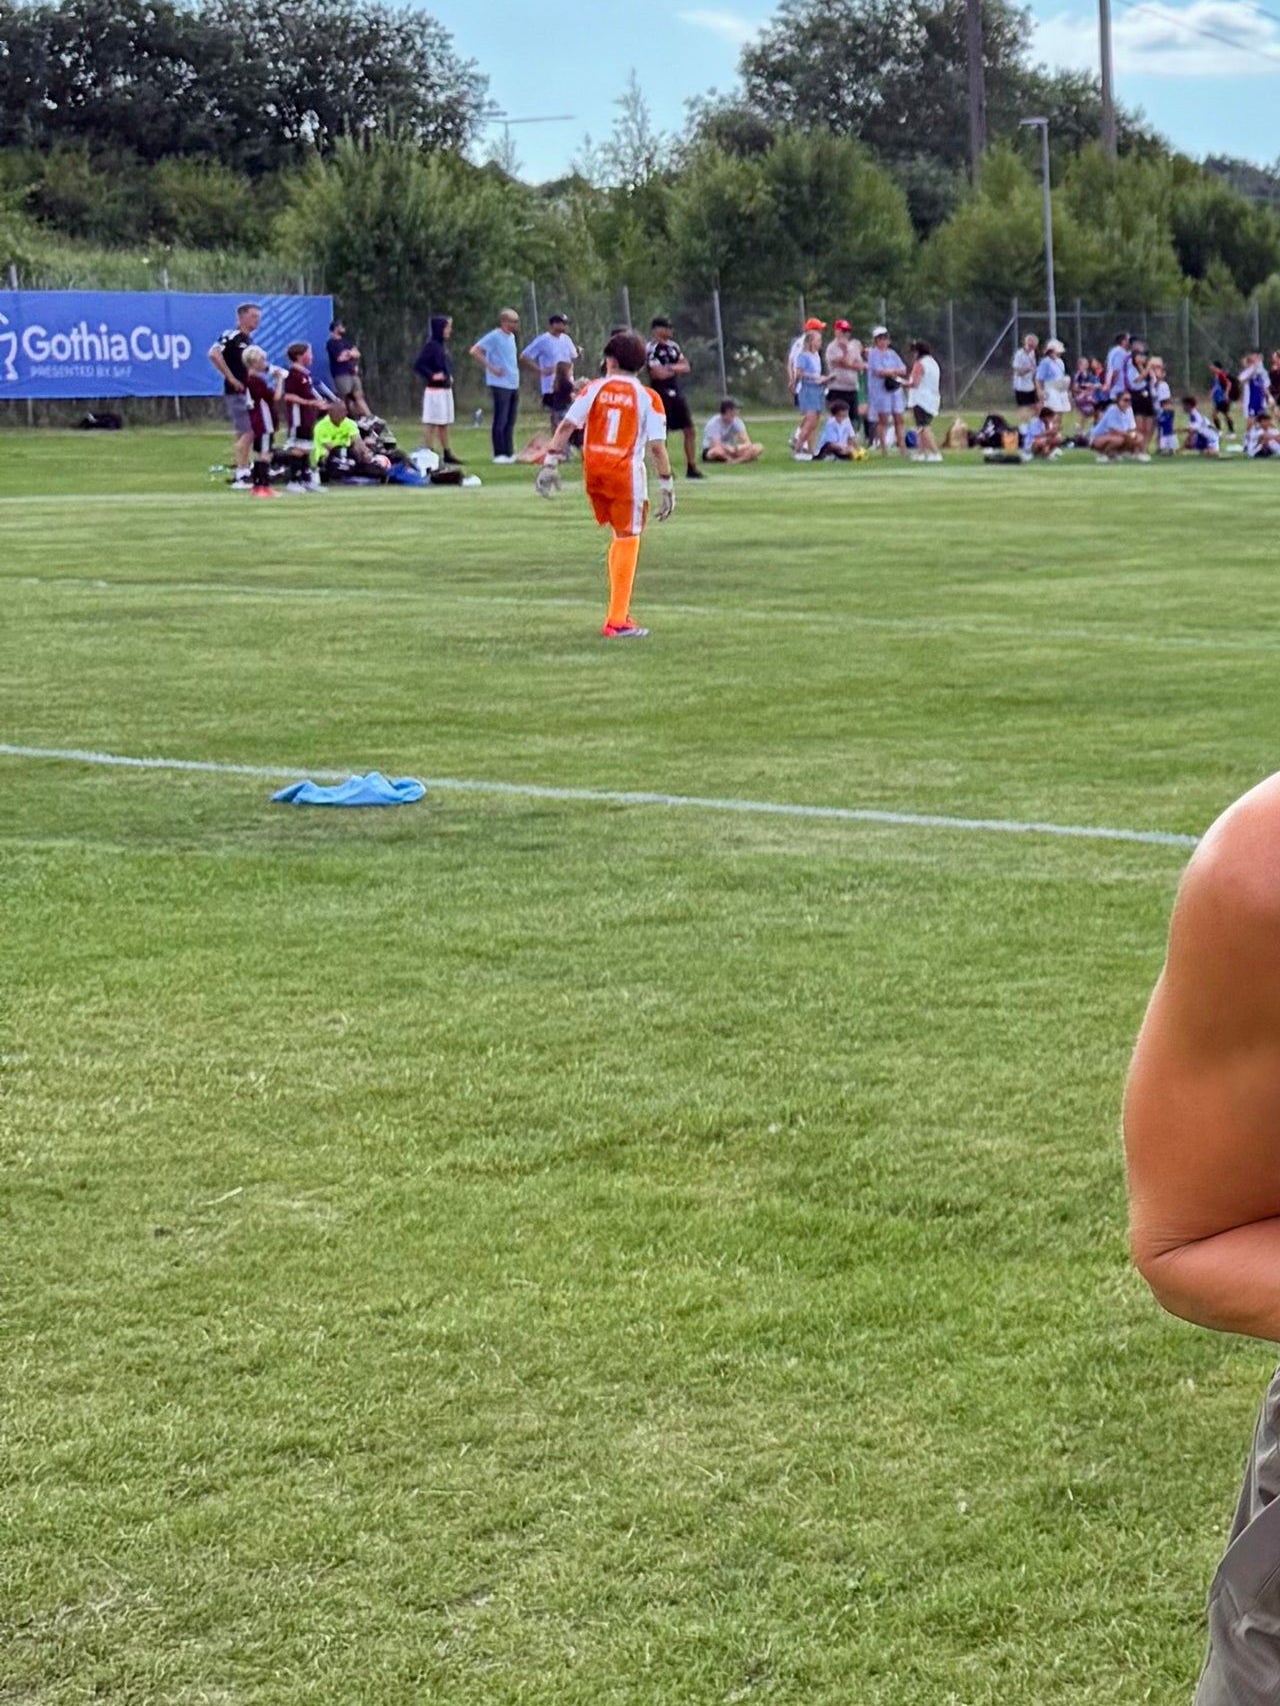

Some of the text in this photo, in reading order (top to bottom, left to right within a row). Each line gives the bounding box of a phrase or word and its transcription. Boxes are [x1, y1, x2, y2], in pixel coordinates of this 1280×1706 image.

[22, 321, 191, 369] Gothia Cup
[606, 408, 621, 444] 1
